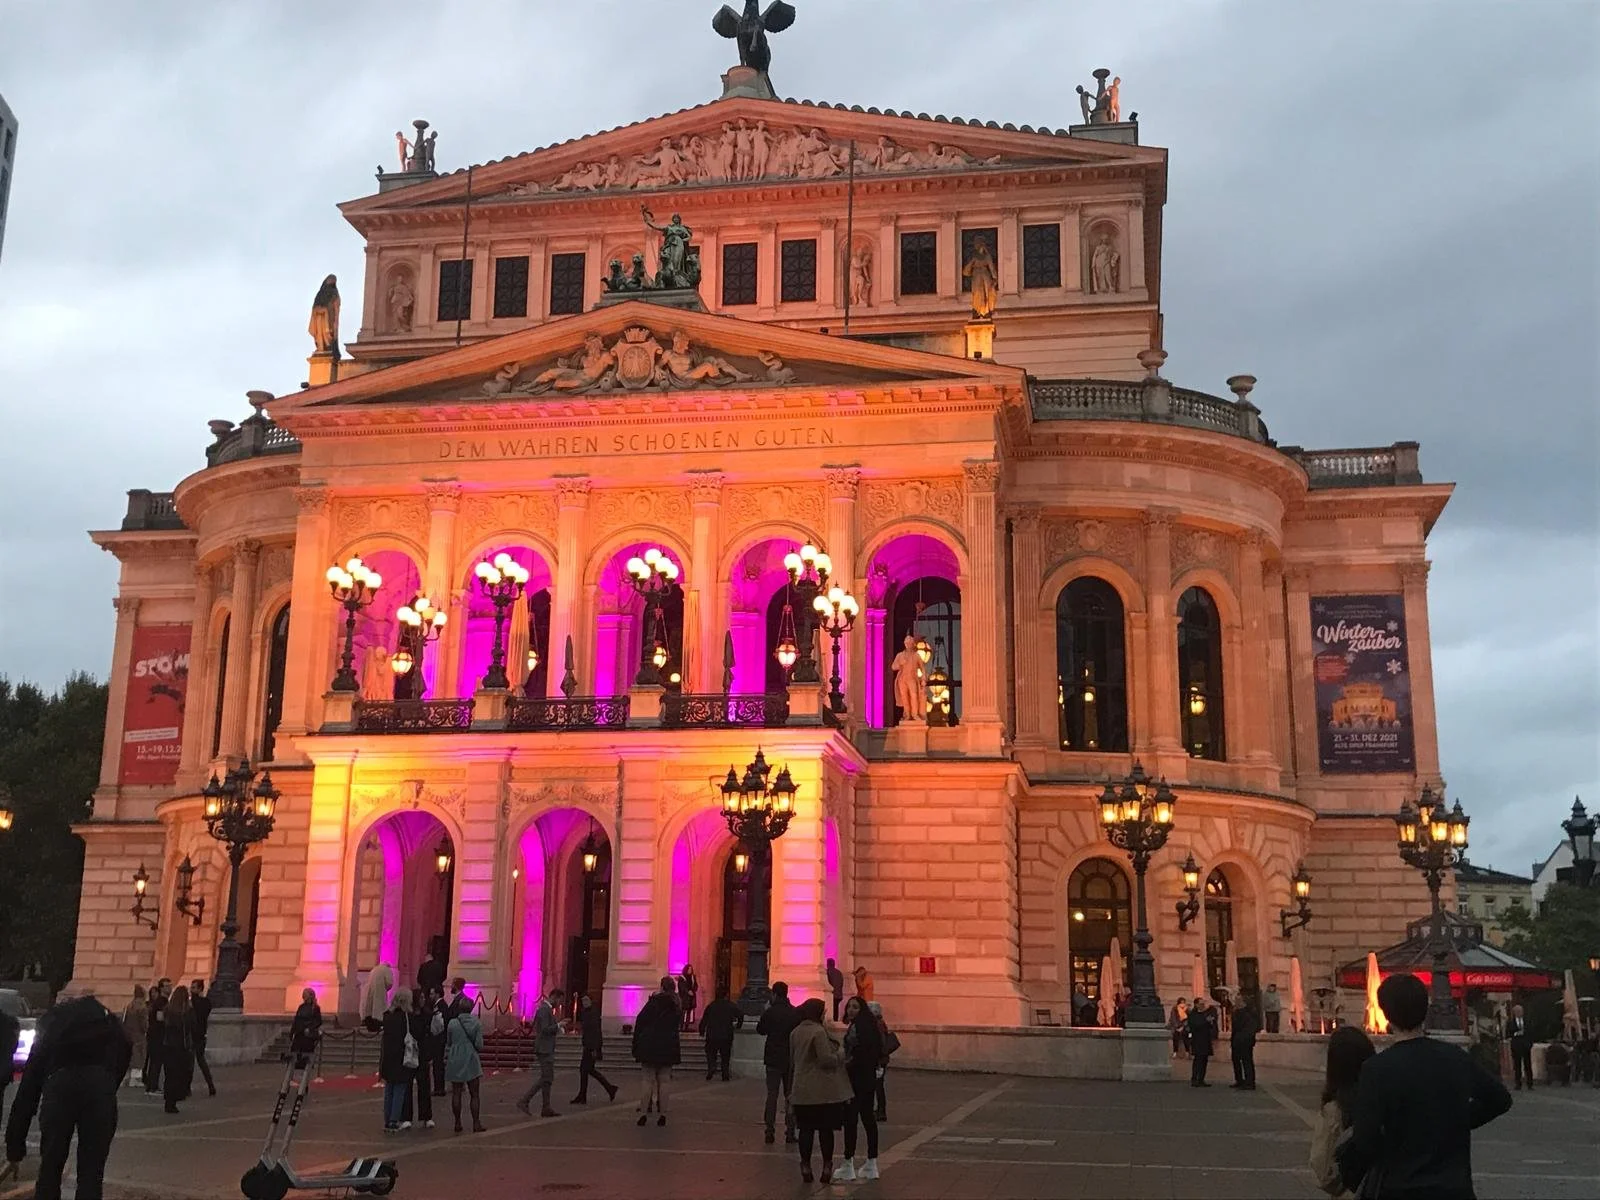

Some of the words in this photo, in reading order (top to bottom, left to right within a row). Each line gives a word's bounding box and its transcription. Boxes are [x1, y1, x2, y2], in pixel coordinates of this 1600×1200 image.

[439, 441, 486, 458] DEM
[499, 436, 599, 456] WAHREN
[613, 431, 740, 451] SCHOENEN
